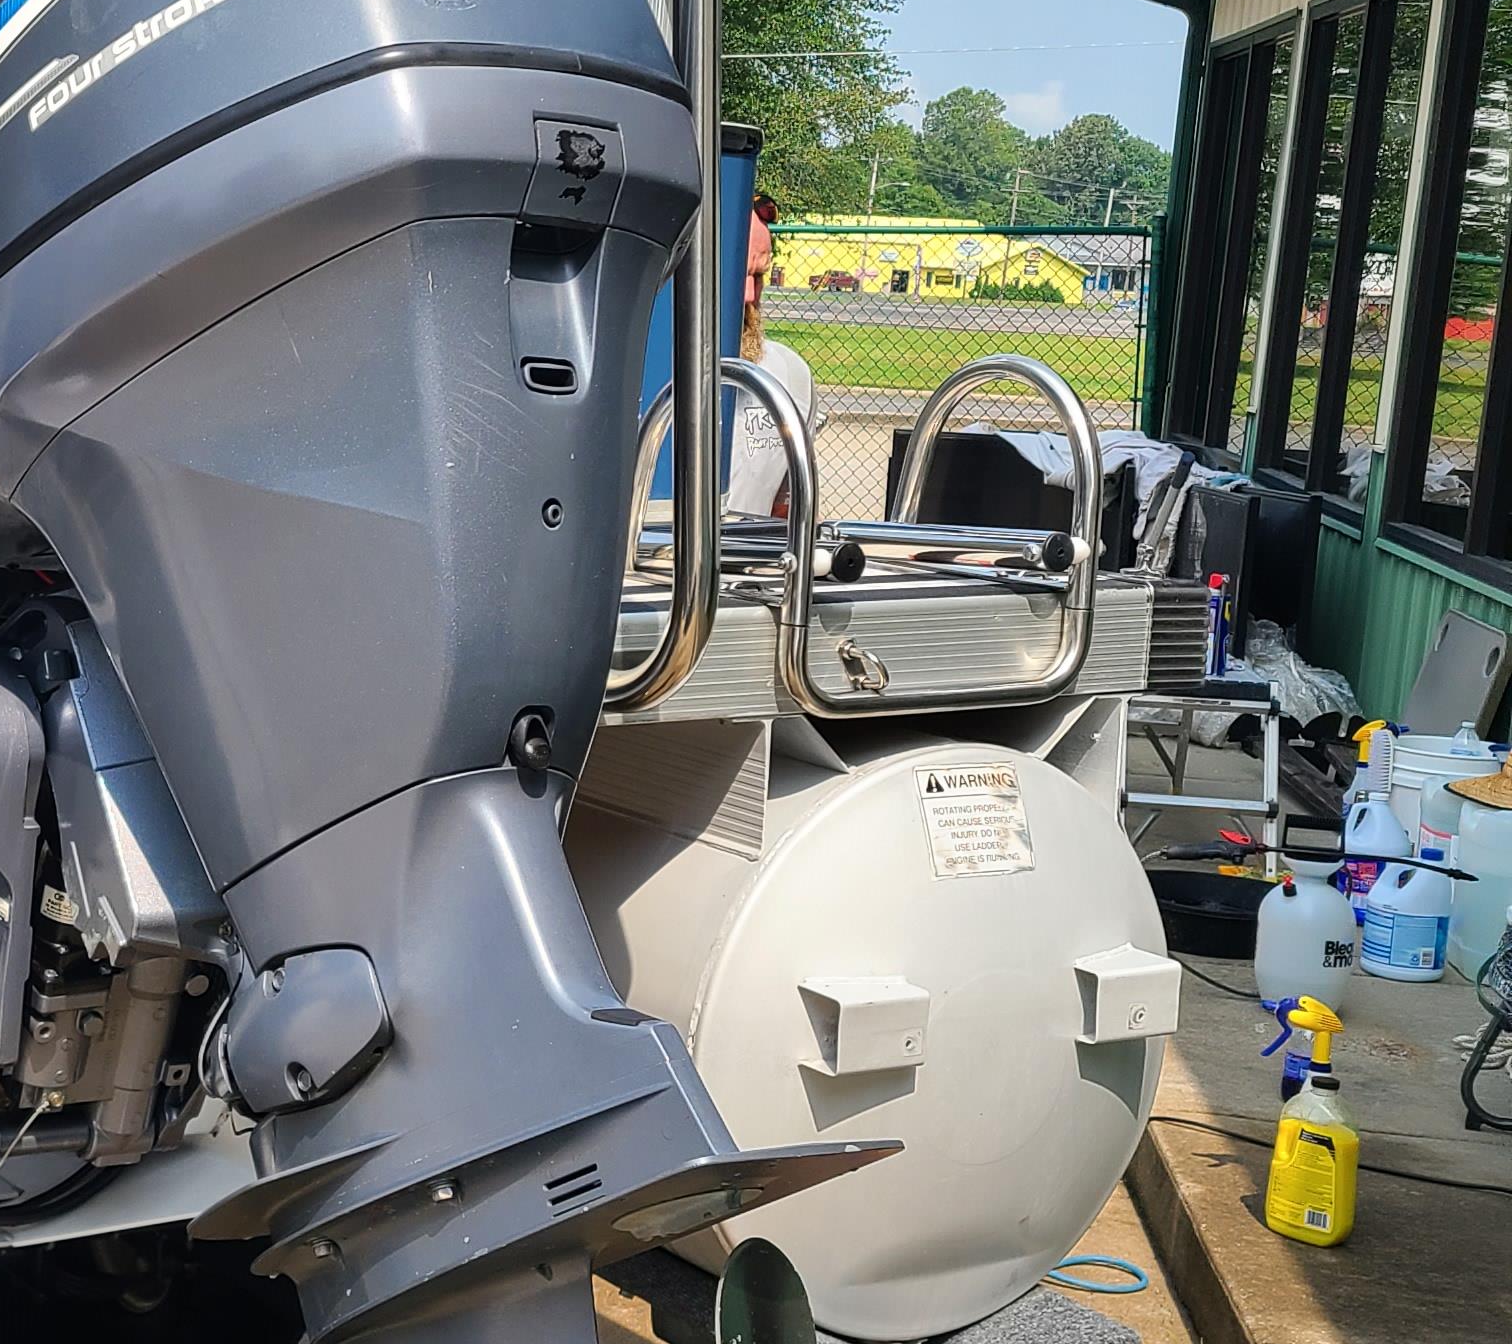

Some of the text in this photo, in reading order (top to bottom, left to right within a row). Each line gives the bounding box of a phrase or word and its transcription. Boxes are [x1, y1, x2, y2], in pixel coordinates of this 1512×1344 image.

[943, 772, 1018, 789] WARNING
[932, 805, 972, 816] ROTATING
[938, 819, 956, 828] CAN
[956, 817, 983, 826] CAUSE
[981, 828, 993, 838] DO
[954, 843, 971, 852] USE
